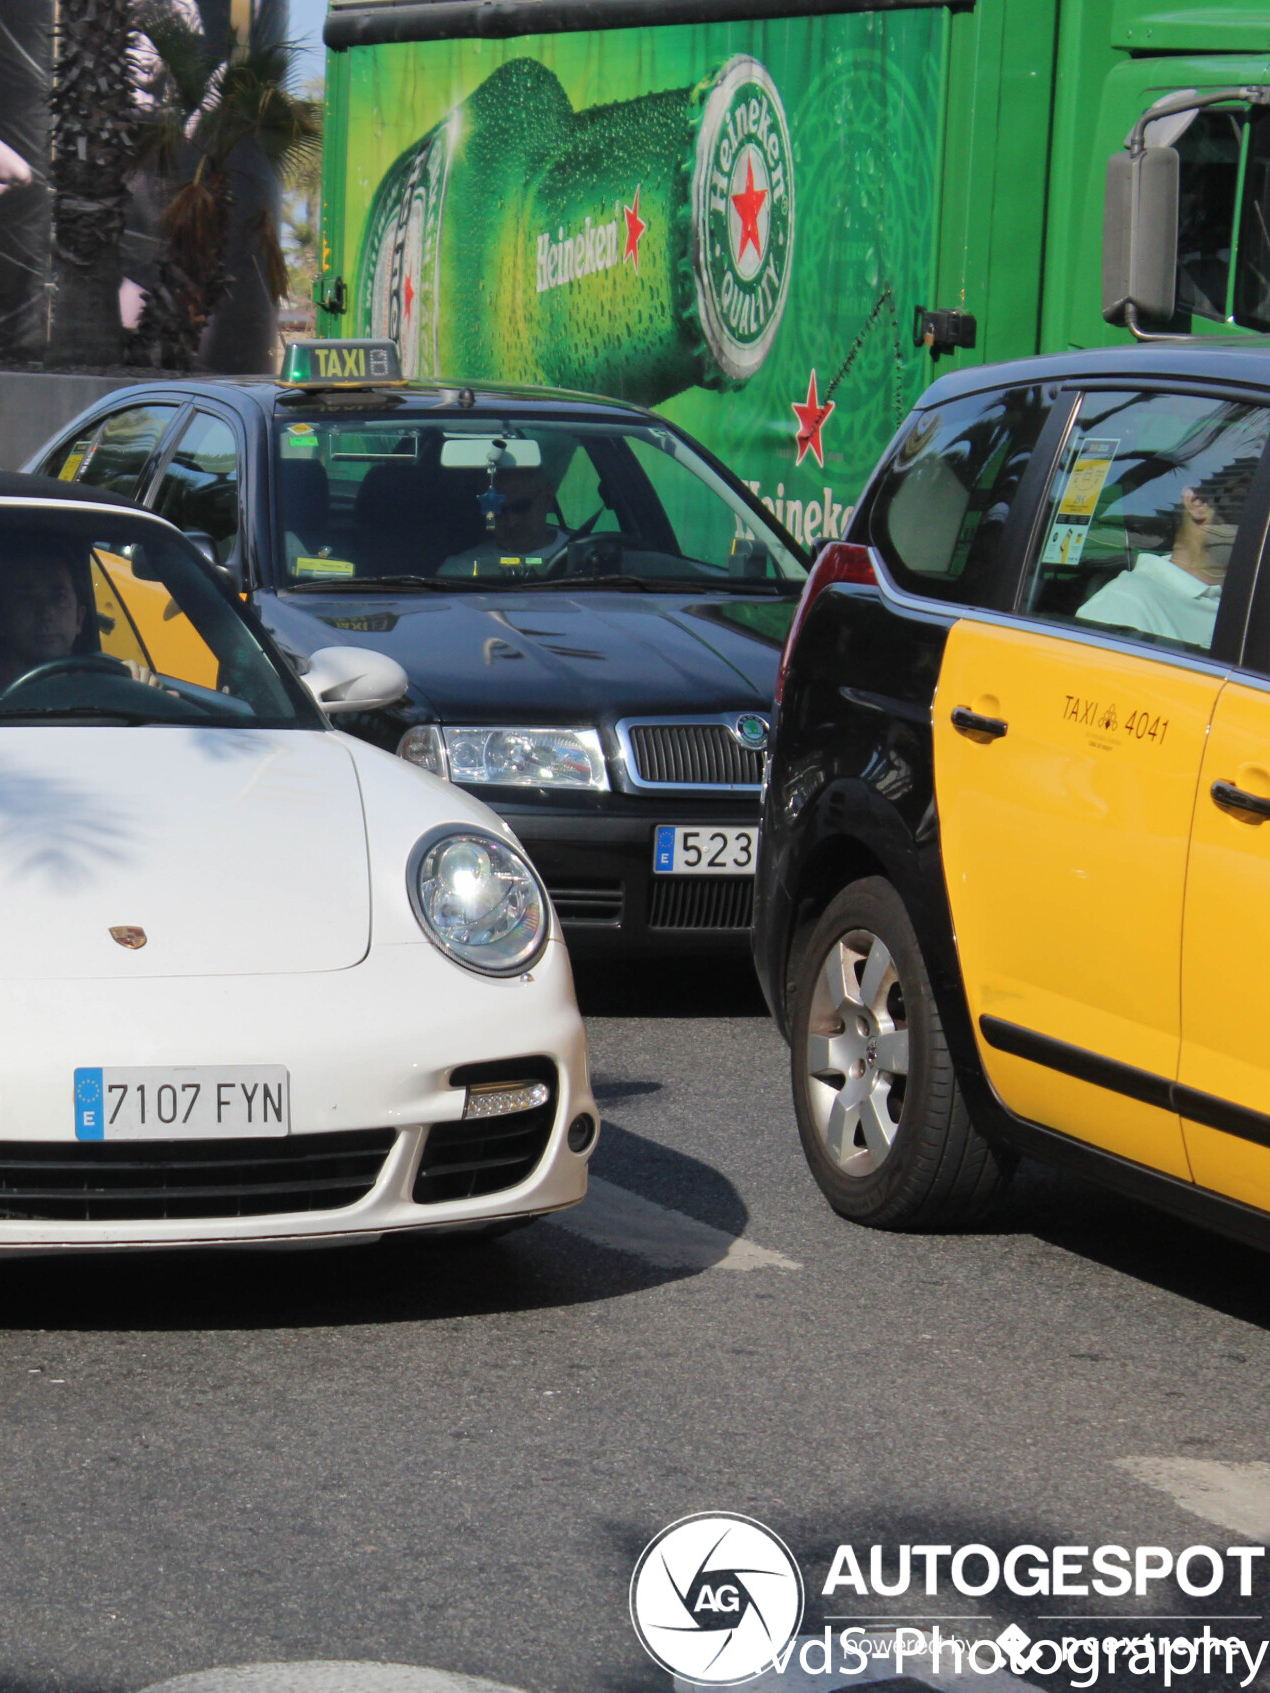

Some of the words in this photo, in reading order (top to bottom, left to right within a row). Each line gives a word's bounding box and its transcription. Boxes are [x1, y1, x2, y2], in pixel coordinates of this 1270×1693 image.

[709, 97, 785, 216] Heineken
[536, 216, 618, 292] Heineken
[722, 251, 779, 335] QUALITY
[315, 349, 365, 377] TAXI
[1063, 695, 1098, 726] TAXI
[1125, 710, 1169, 744] 4041
[661, 853, 669, 863] E
[83, 1111, 95, 1126] E
[108, 1084, 201, 1124] 7107
[217, 1083, 282, 1123] FYN
